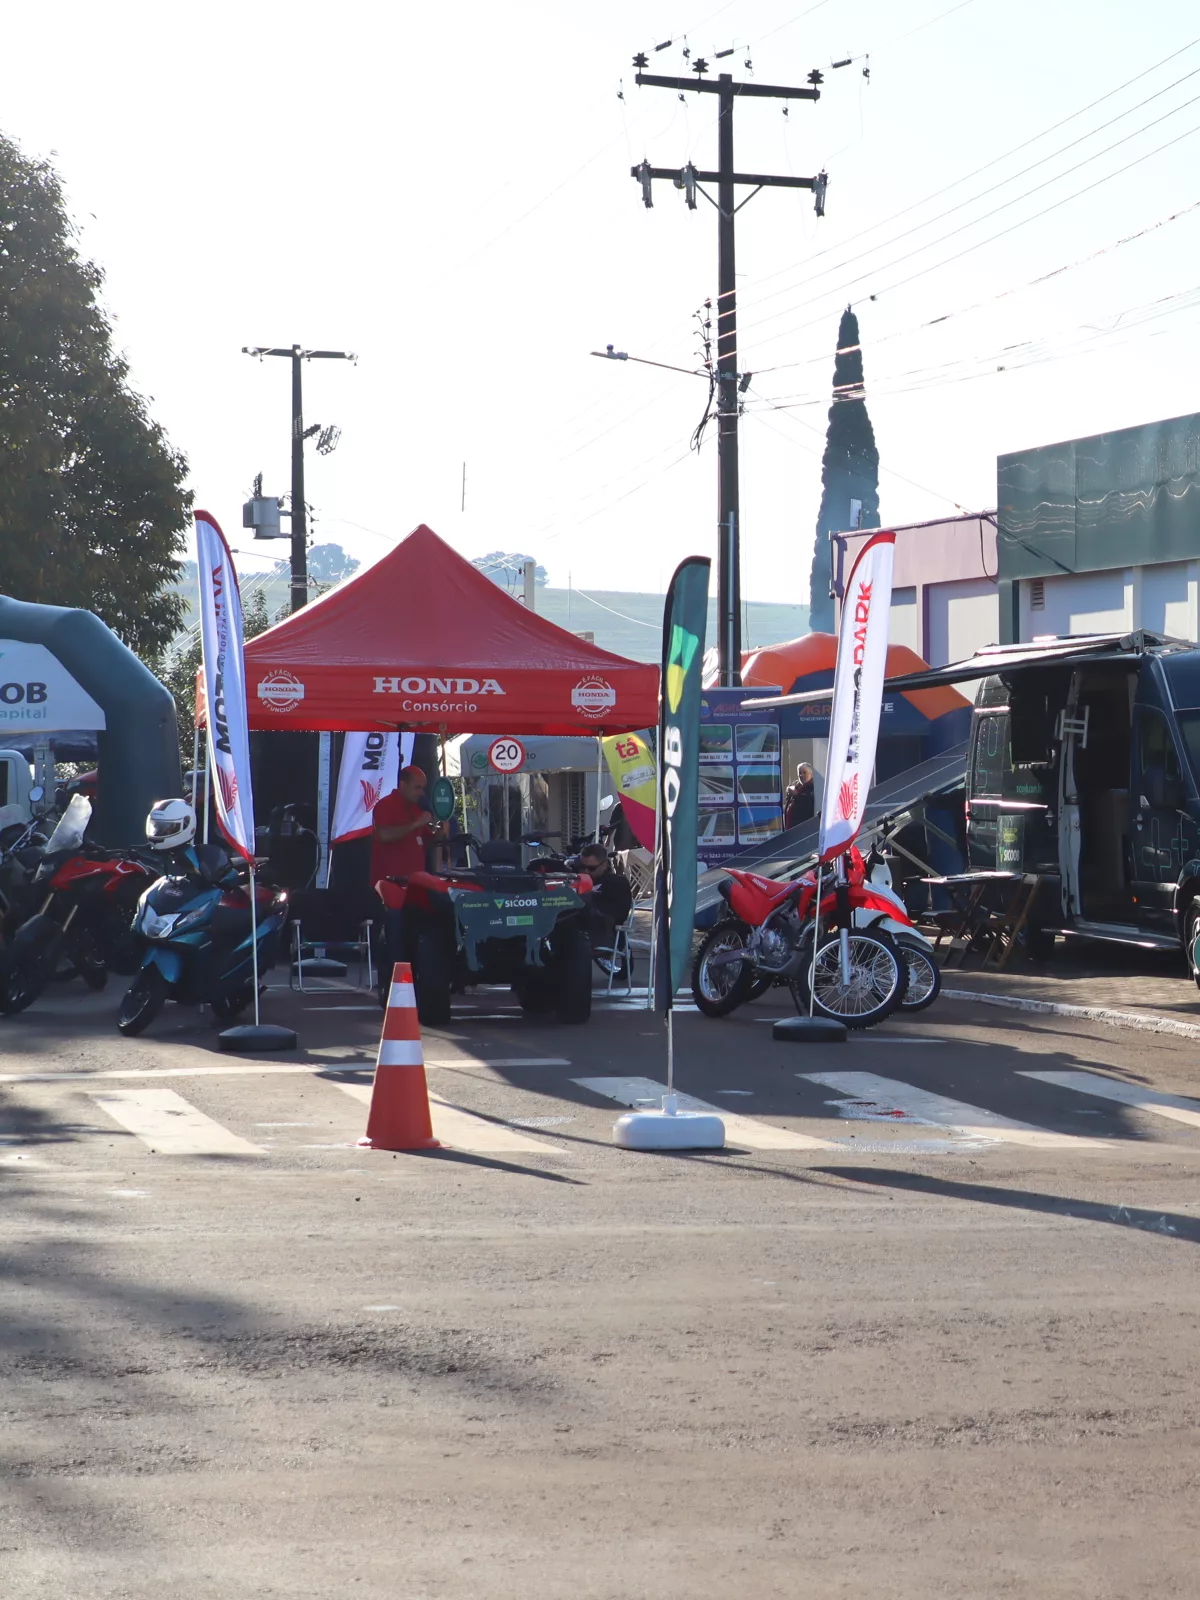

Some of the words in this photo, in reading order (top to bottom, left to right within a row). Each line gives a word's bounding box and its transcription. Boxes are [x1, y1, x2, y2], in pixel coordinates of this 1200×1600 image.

[0, 682, 48, 704] OB
[372, 677, 506, 695] HONDA
[402, 699, 477, 712] Consórcio
[495, 744, 518, 760] 20
[615, 737, 639, 759] tá
[504, 898, 538, 908] SICOOB
